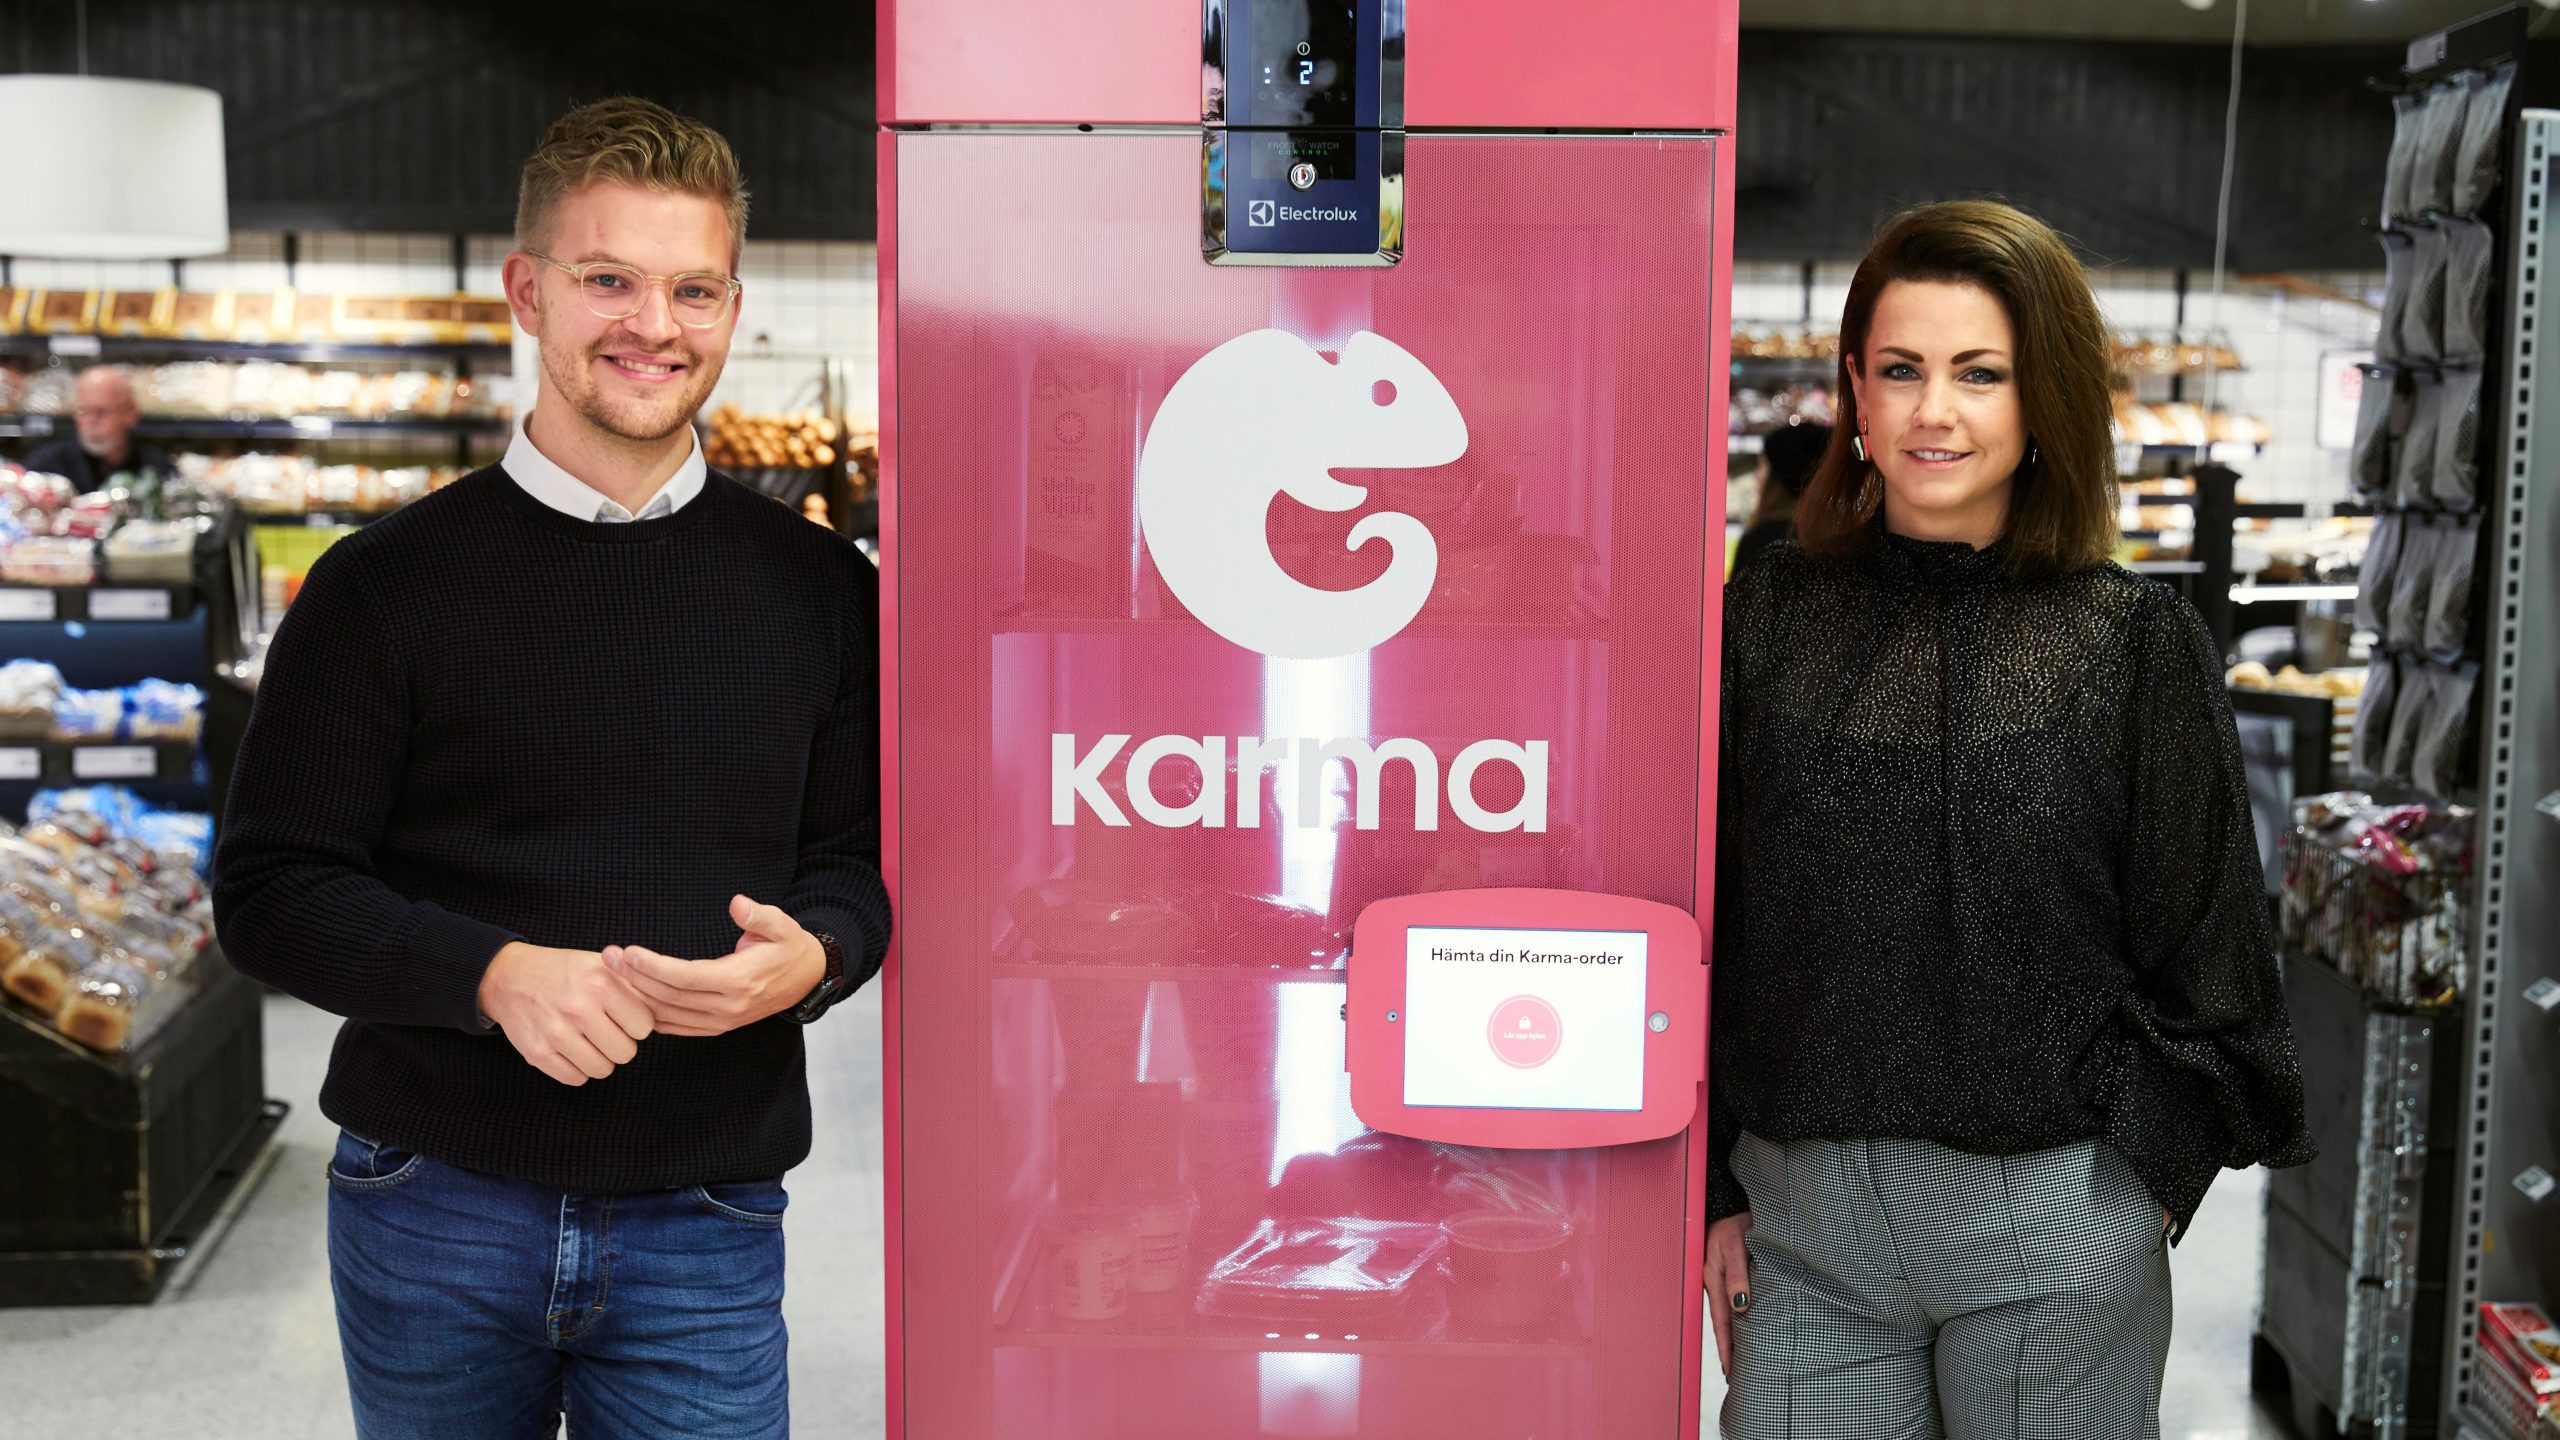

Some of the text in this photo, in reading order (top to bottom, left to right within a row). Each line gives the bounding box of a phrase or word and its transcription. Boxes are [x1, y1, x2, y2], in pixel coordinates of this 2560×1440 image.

[1300, 61, 1312, 85] 2
[1309, 142, 1339, 150] WATCH
[1279, 206, 1357, 221] Electrolux
[1050, 732, 1549, 833] karma
[1431, 947, 1624, 965] Hämta din Karma-order
